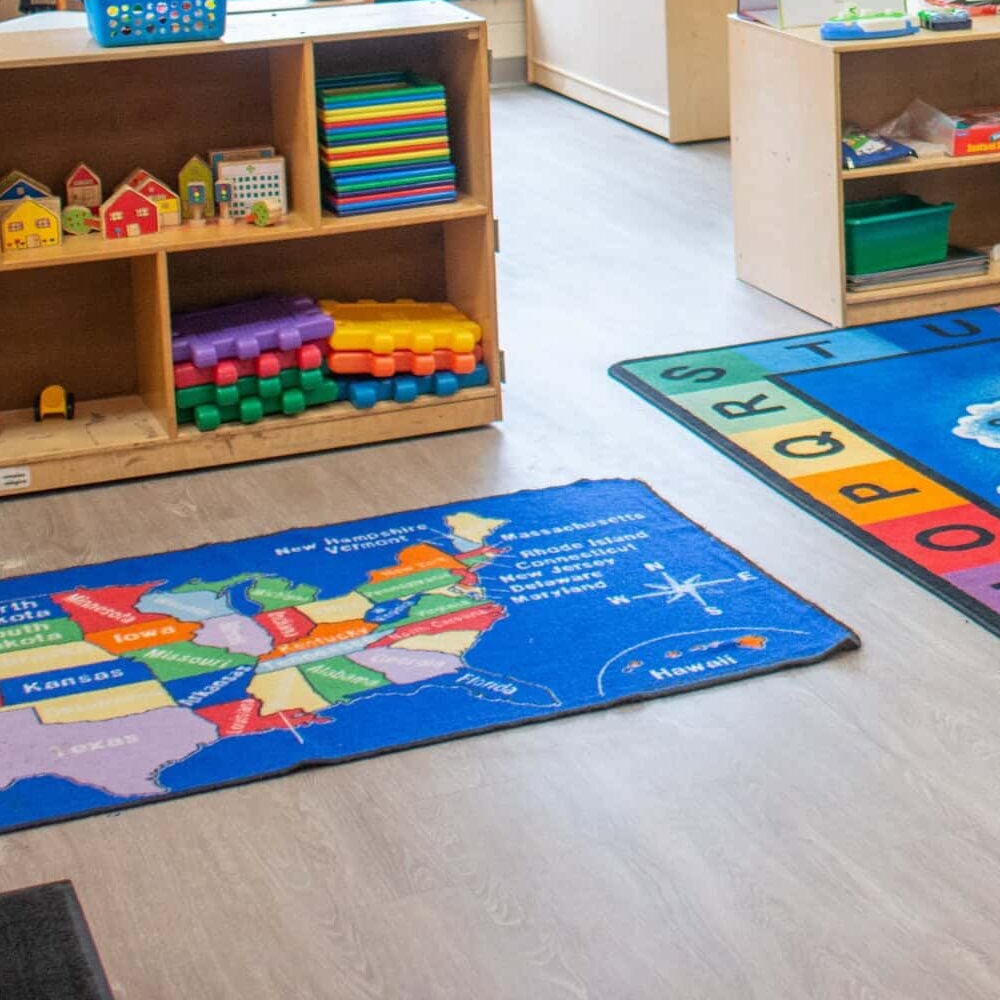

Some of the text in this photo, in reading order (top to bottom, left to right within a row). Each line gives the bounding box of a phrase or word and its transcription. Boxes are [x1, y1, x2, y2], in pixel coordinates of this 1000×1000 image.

[661, 362, 727, 386] S
[787, 338, 838, 361] T
[927, 317, 981, 340] U
[712, 392, 788, 420] R
[773, 431, 845, 460] Q
[839, 481, 922, 506] P
[274, 524, 428, 556] New Hampshire
[500, 513, 646, 542] Massachusetts
[914, 523, 996, 552] O
[324, 535, 409, 555] Vermont
[515, 542, 639, 571] Connecticut
[520, 530, 650, 559] Rhode Island
[499, 557, 615, 585] New Jersey
[643, 561, 665, 573] N
[735, 570, 759, 582] E
[509, 570, 603, 593] Delaware
[510, 580, 608, 605] Maryland
[606, 595, 632, 606] W
[704, 606, 723, 616] S
[112, 625, 177, 644] Iowa
[144, 648, 232, 669] Missouri
[650, 653, 739, 681] Hawaii
[22, 668, 125, 694] Kansas
[51, 733, 141, 758] Texas
